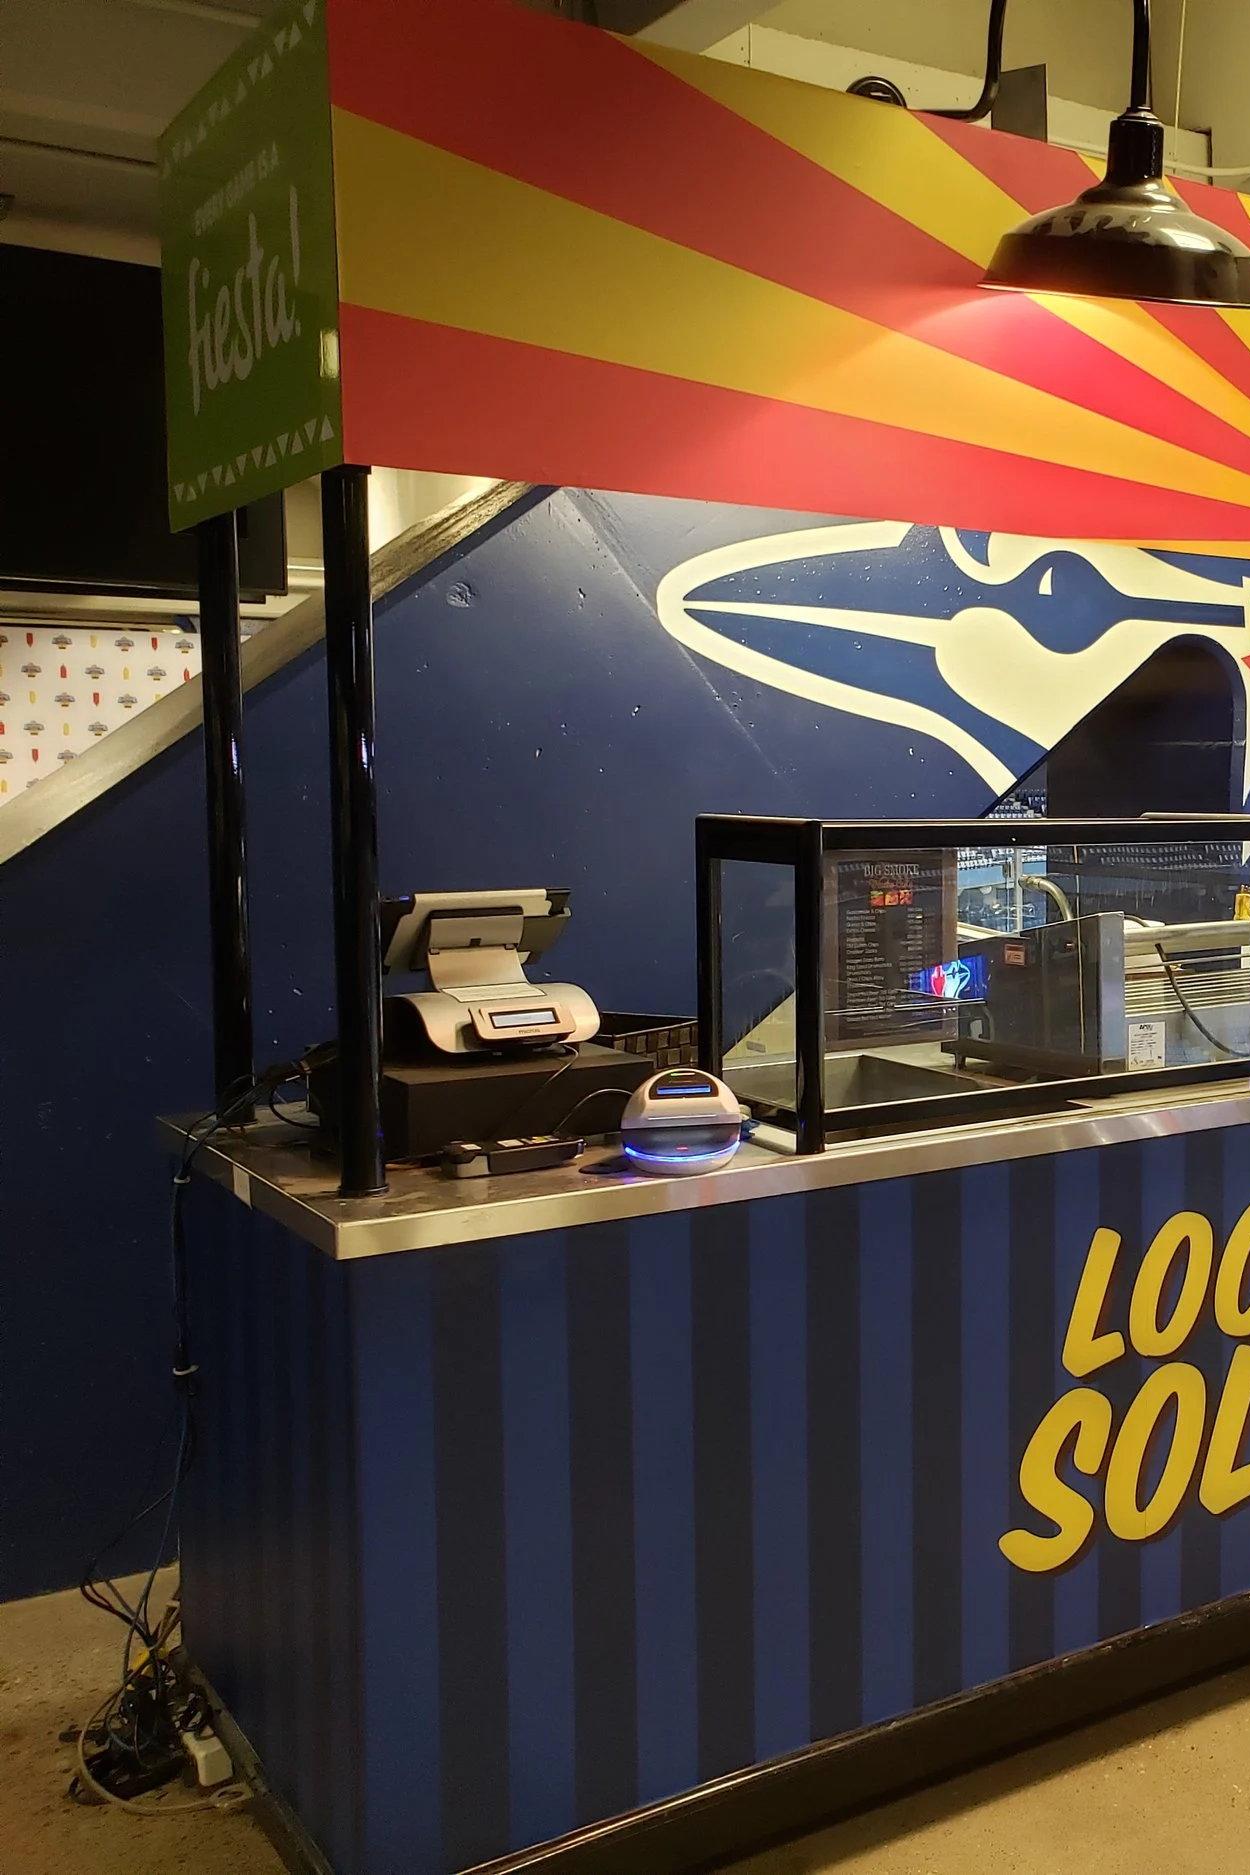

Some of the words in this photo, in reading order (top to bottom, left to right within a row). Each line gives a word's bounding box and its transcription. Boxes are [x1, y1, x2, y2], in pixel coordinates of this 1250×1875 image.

[187, 184, 301, 418] fiesta!
[863, 864, 882, 877] BIG
[883, 863, 920, 876] SMOKE
